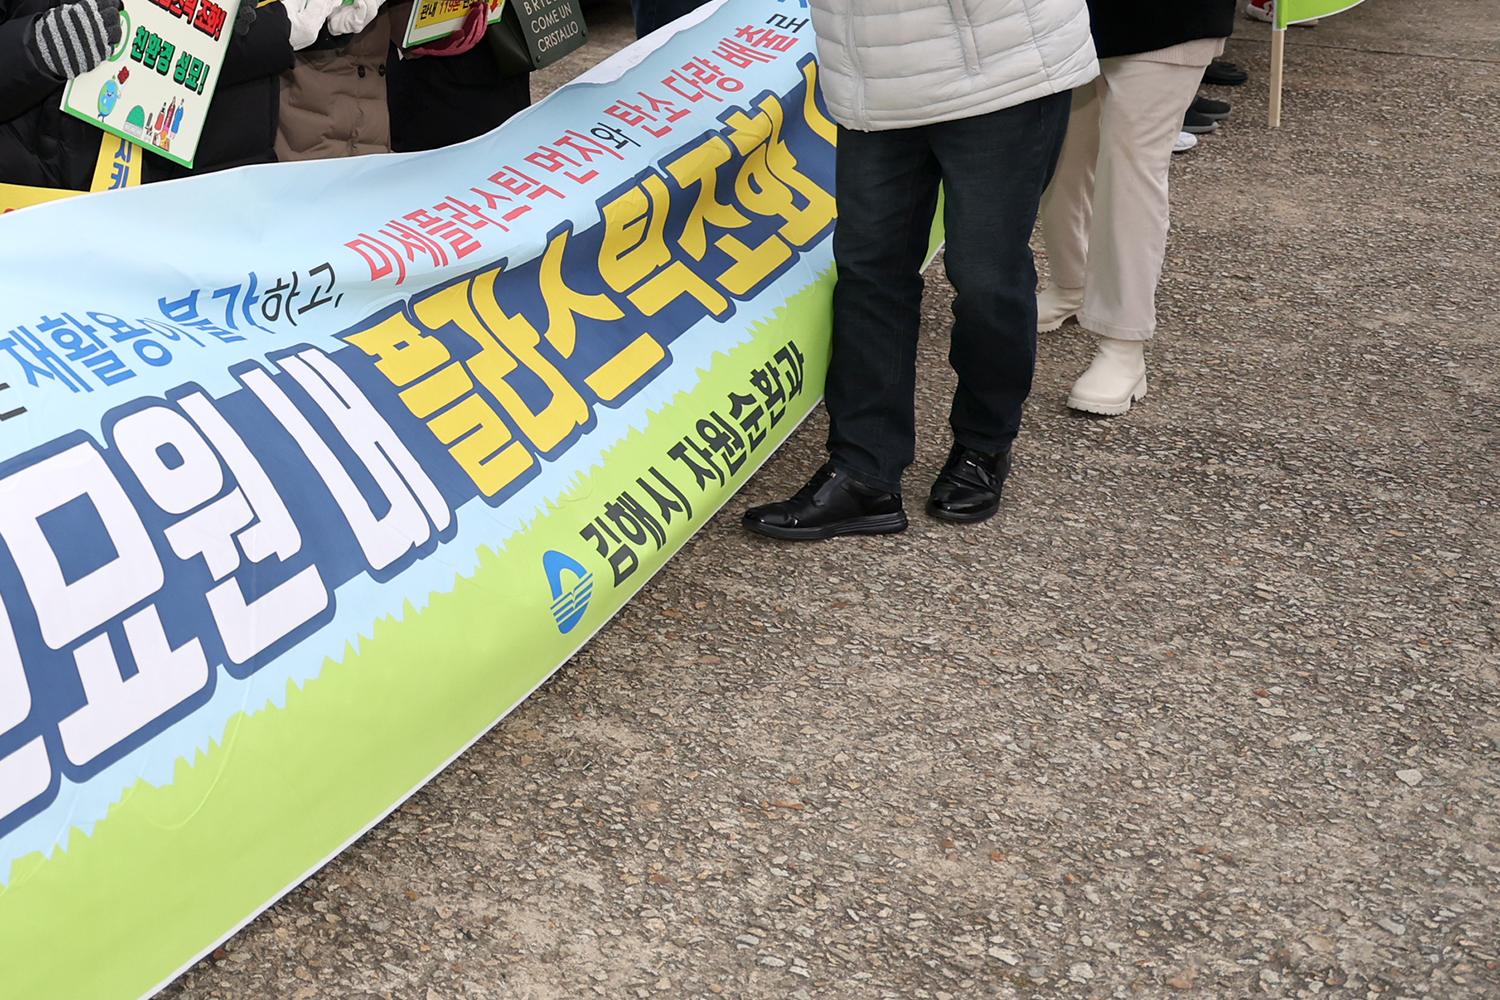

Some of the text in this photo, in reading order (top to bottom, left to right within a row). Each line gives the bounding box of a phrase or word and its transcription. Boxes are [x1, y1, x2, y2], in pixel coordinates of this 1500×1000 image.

[420, 2, 437, 20] 관내
[530, 2, 573, 34] COME UN
[537, 20, 579, 53] CRISTALLO
[130, 25, 211, 97] 친환경 성묘!
[524, 121, 642, 185] 먼지와
[603, 90, 692, 139] 탄소
[660, 55, 745, 103] 다량
[711, 13, 810, 70] 배출로
[238, 346, 452, 573] 내
[579, 339, 805, 589] 김해시 자원순환과
